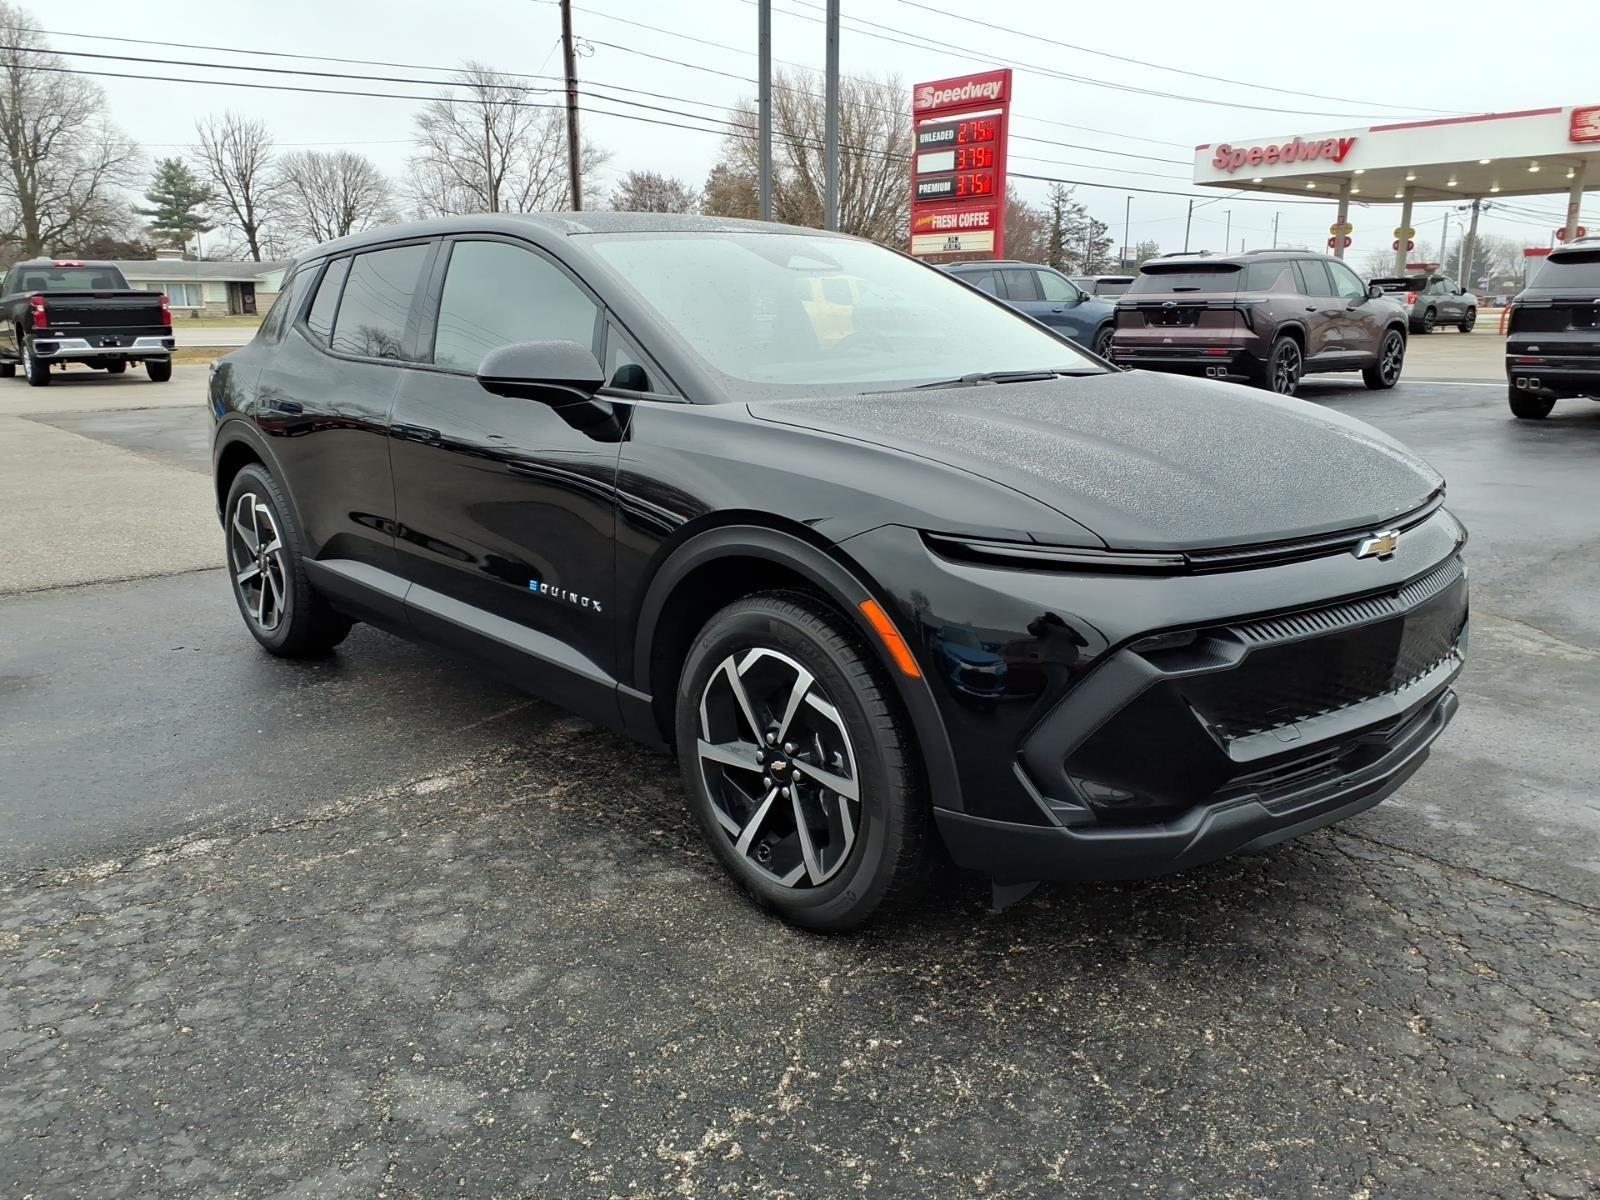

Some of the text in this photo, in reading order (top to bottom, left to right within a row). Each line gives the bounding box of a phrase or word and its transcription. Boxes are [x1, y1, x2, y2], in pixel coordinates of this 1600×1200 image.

[919, 81, 1002, 108] Speedway
[920, 130, 954, 143] UNLEADED
[1212, 136, 1357, 173] Speedway
[919, 182, 951, 194] PREMIUM
[932, 214, 957, 229] FRESH
[958, 211, 990, 228] COFFEE
[529, 580, 602, 612] EQUINOX
